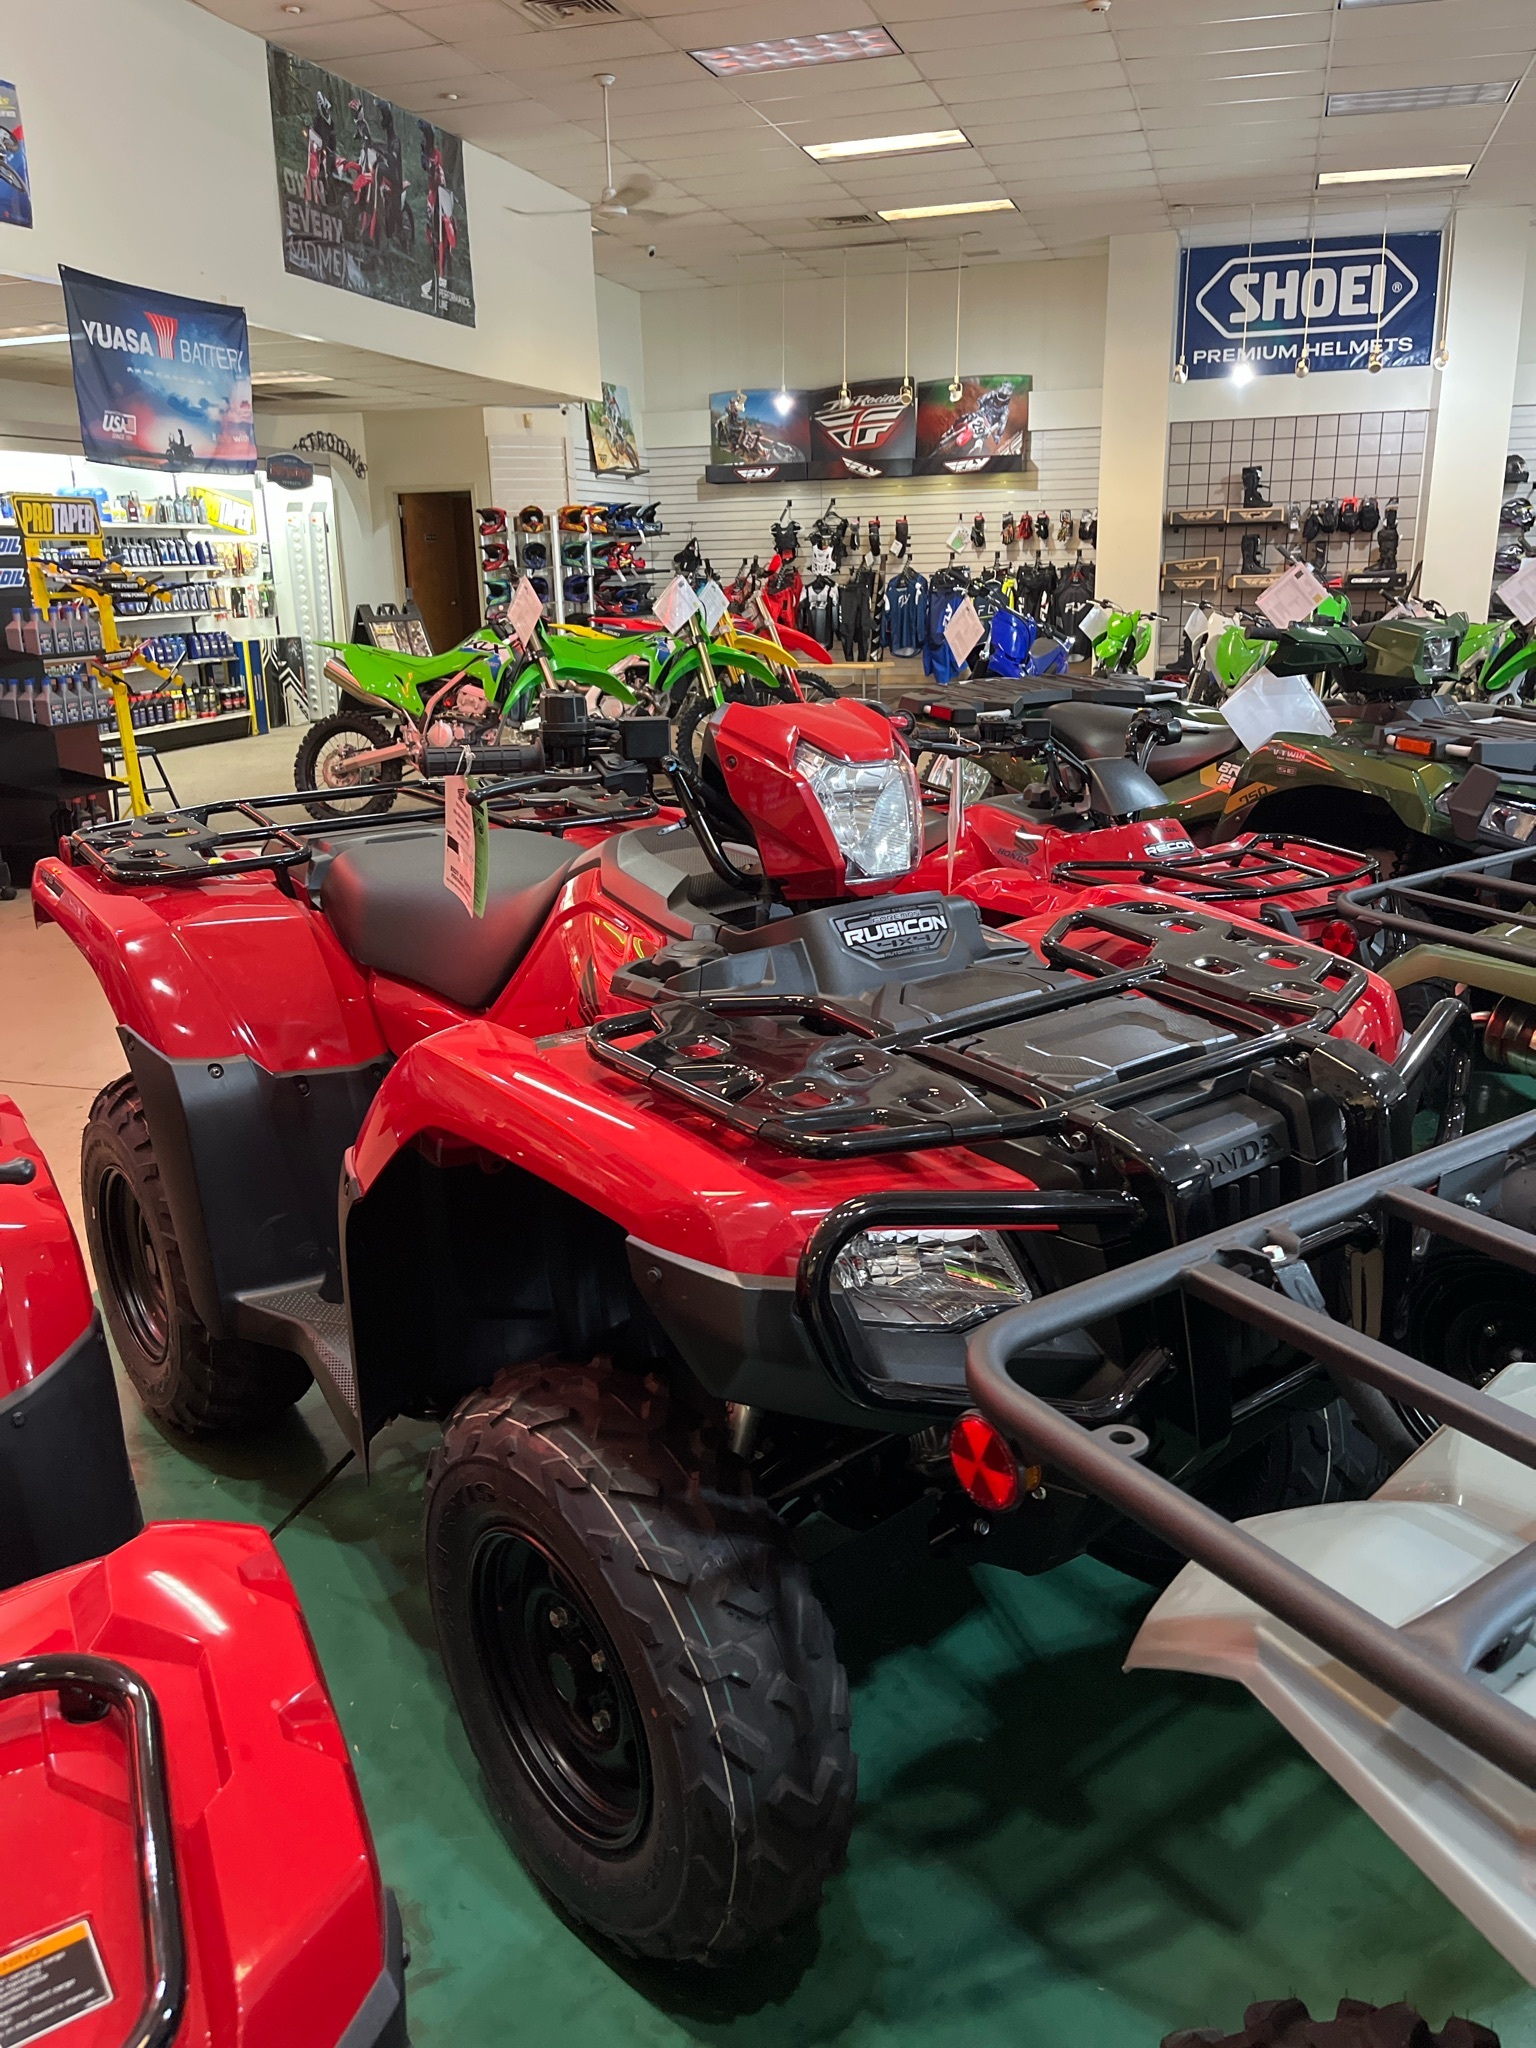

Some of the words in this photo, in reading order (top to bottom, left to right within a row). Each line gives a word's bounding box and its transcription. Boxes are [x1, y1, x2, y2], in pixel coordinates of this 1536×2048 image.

[286, 200, 345, 244] EVERY
[1229, 264, 1387, 323] SHOEI
[82, 319, 154, 357] YUASA
[180, 339, 244, 373] BATTERY
[1193, 344, 1297, 364] PREMIUM
[1306, 337, 1413, 357] HELMETS
[102, 413, 127, 433] USA
[1, 570, 24, 586] OIL
[1065, 601, 1086, 614] FLY
[1239, 785, 1269, 804] 750
[996, 847, 1030, 866] HONDA
[1143, 840, 1195, 856] RECON
[843, 915, 948, 947] RUBICON
[1200, 1132, 1281, 1175] ONDA
